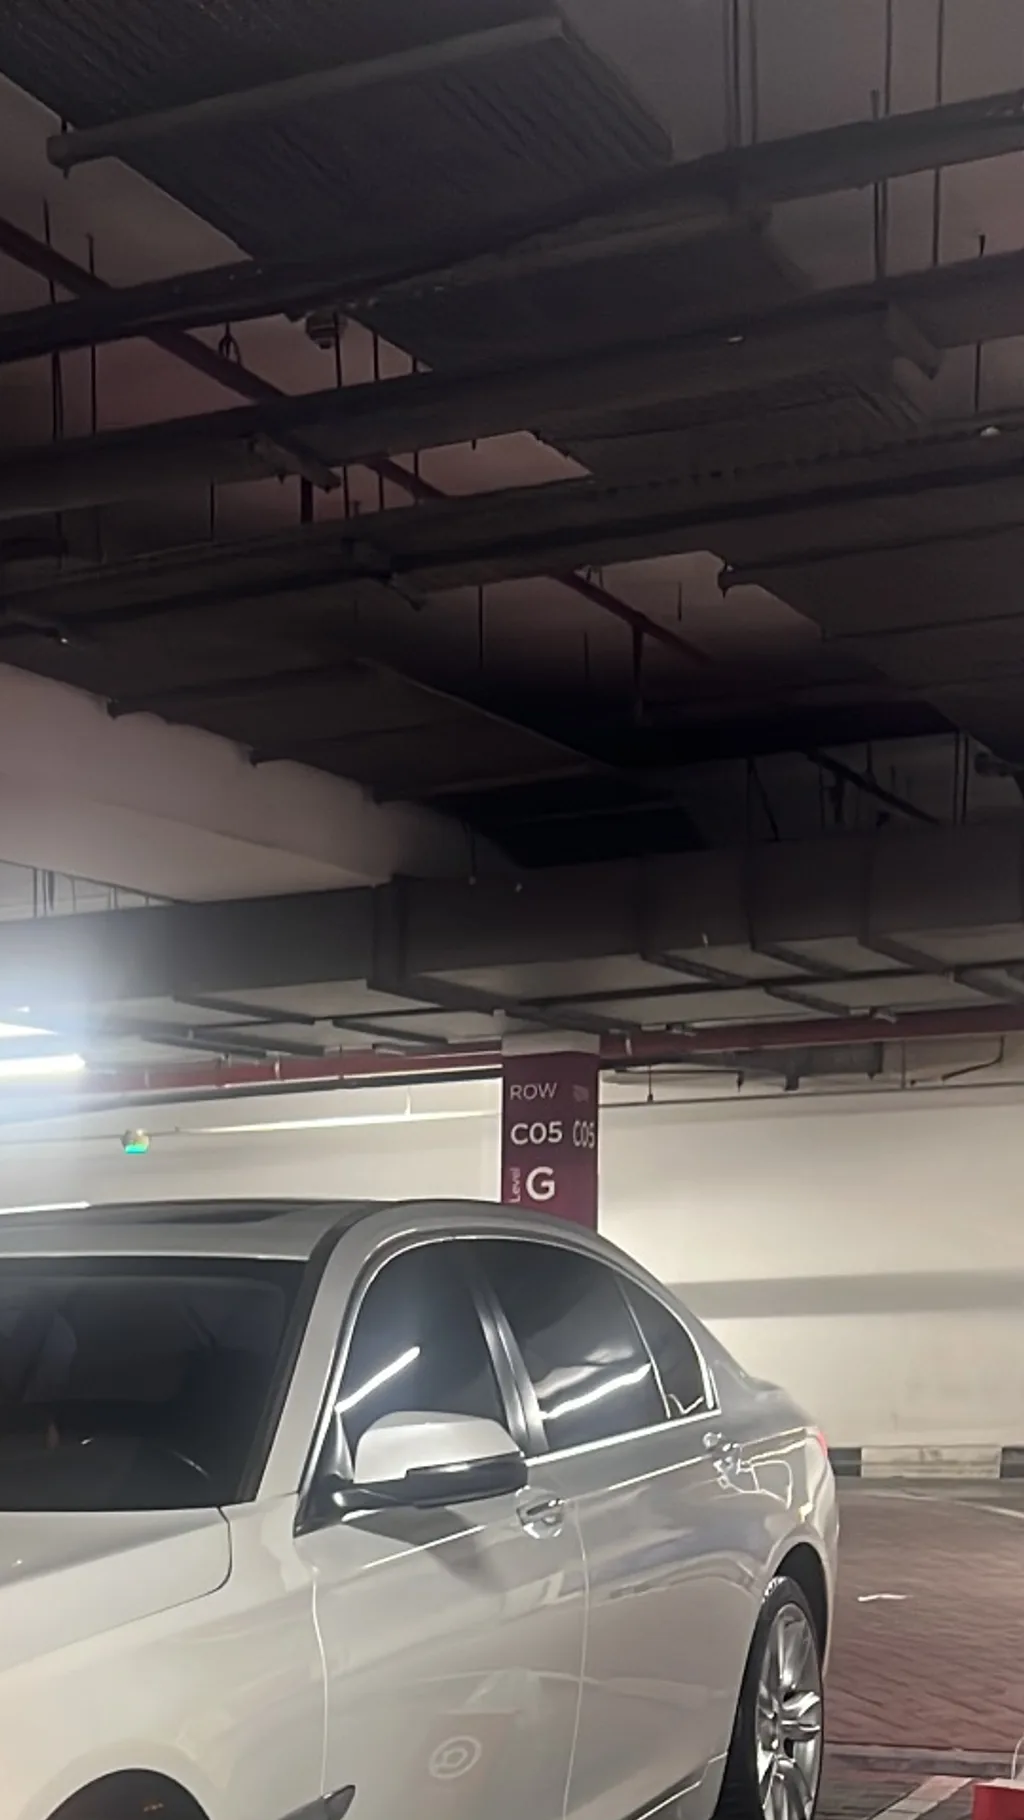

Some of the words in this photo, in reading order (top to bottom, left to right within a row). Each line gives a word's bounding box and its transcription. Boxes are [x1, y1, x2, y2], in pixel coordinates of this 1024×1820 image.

[510, 1082, 558, 1101] ROW
[510, 1121, 563, 1145] C05
[572, 1120, 596, 1149] C05
[526, 1166, 555, 1201] G
